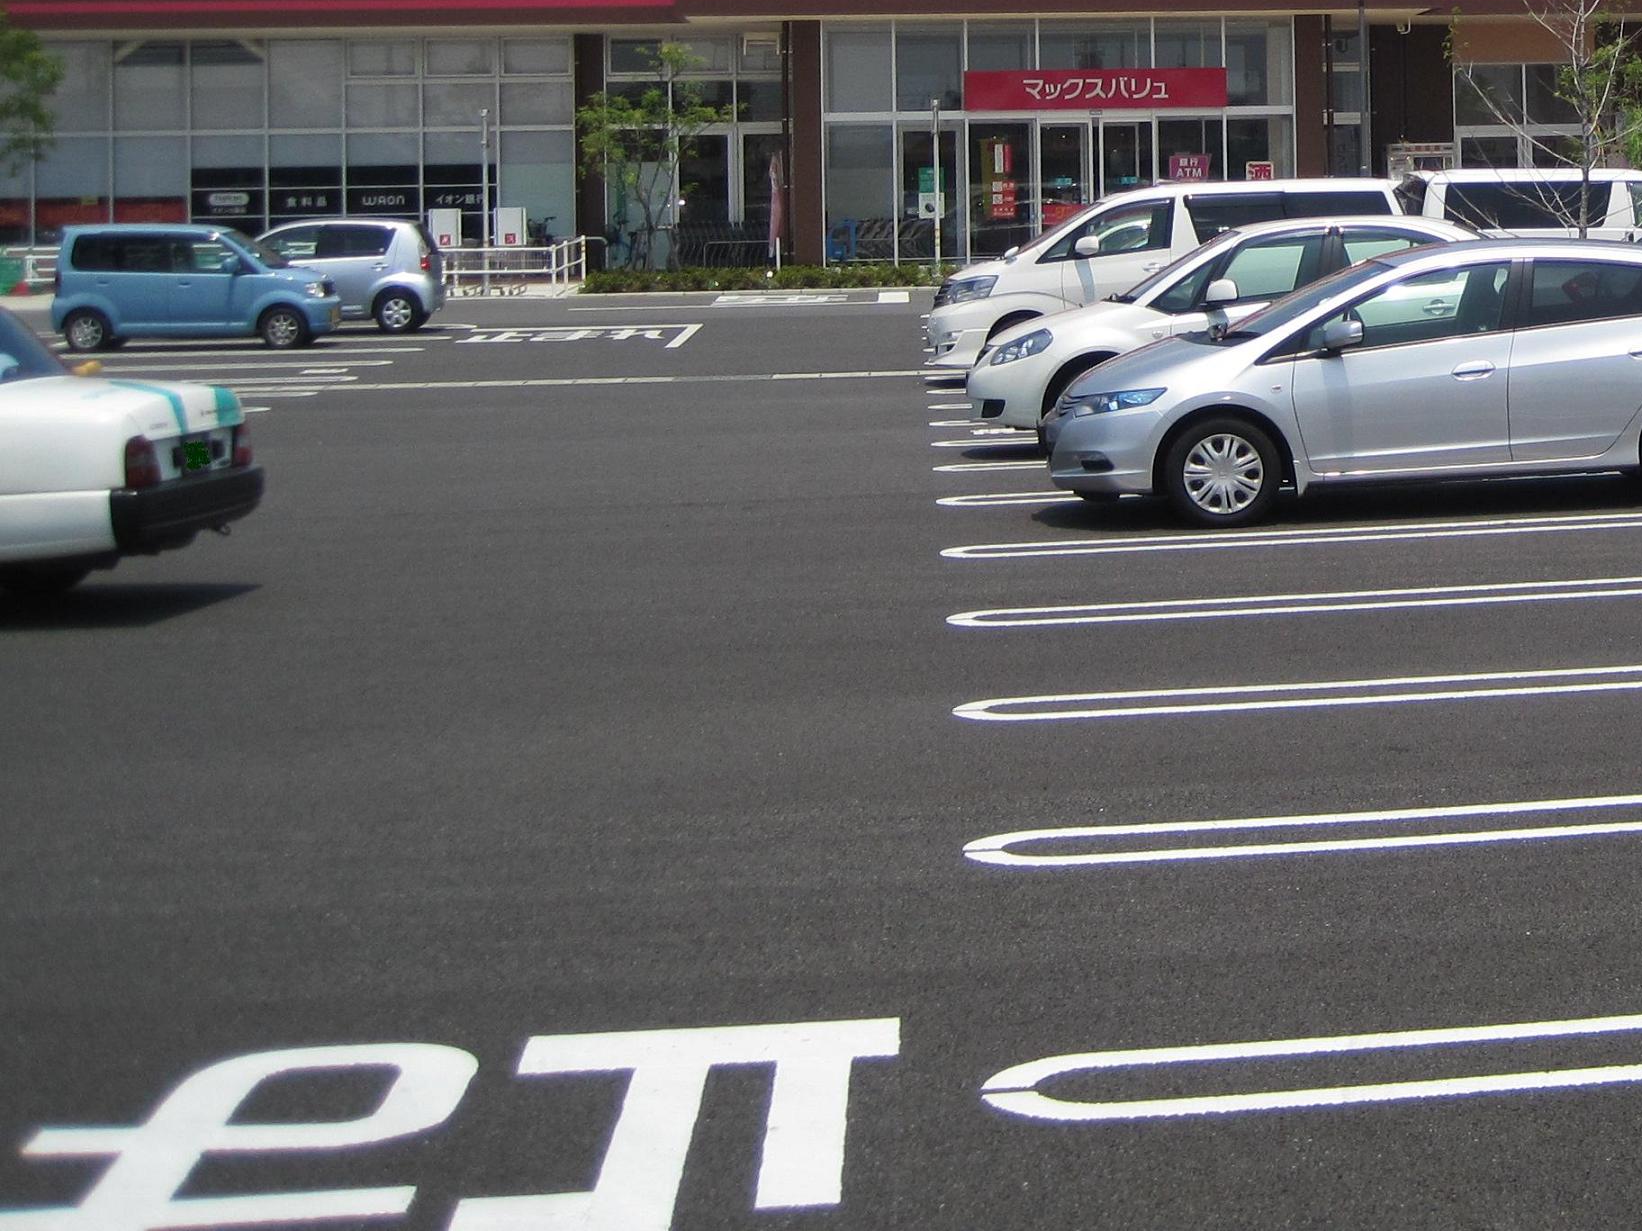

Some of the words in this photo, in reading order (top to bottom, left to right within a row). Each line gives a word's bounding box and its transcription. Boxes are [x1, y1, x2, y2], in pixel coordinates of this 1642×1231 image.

[1022, 77, 1169, 101] マックスバリュ
[1179, 156, 1200, 167] 銀行
[1175, 168, 1203, 179] ATM
[285, 195, 328, 208] 食料品
